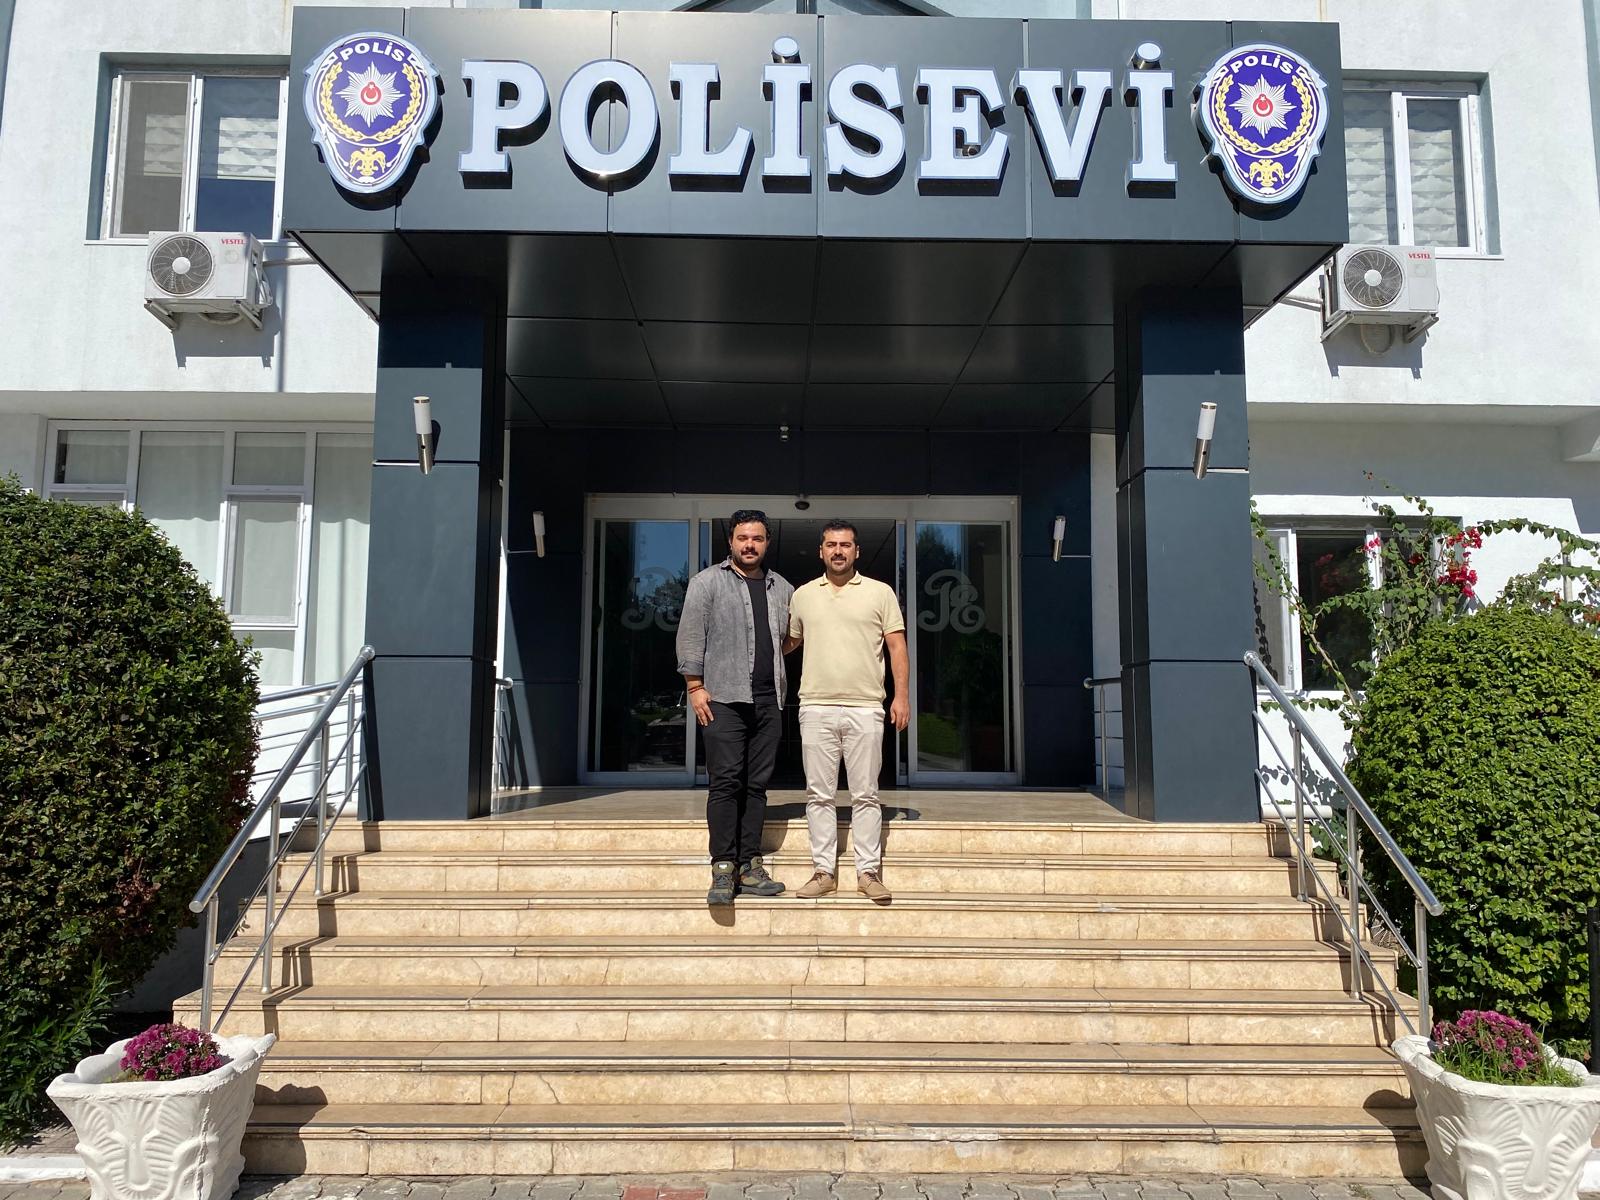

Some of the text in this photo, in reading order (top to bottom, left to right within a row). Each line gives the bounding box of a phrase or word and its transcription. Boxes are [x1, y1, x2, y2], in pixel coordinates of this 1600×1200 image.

[339, 41, 405, 62] POLİS
[1230, 54, 1294, 75] POLİS
[458, 36, 1178, 183] POLİSEVİ
